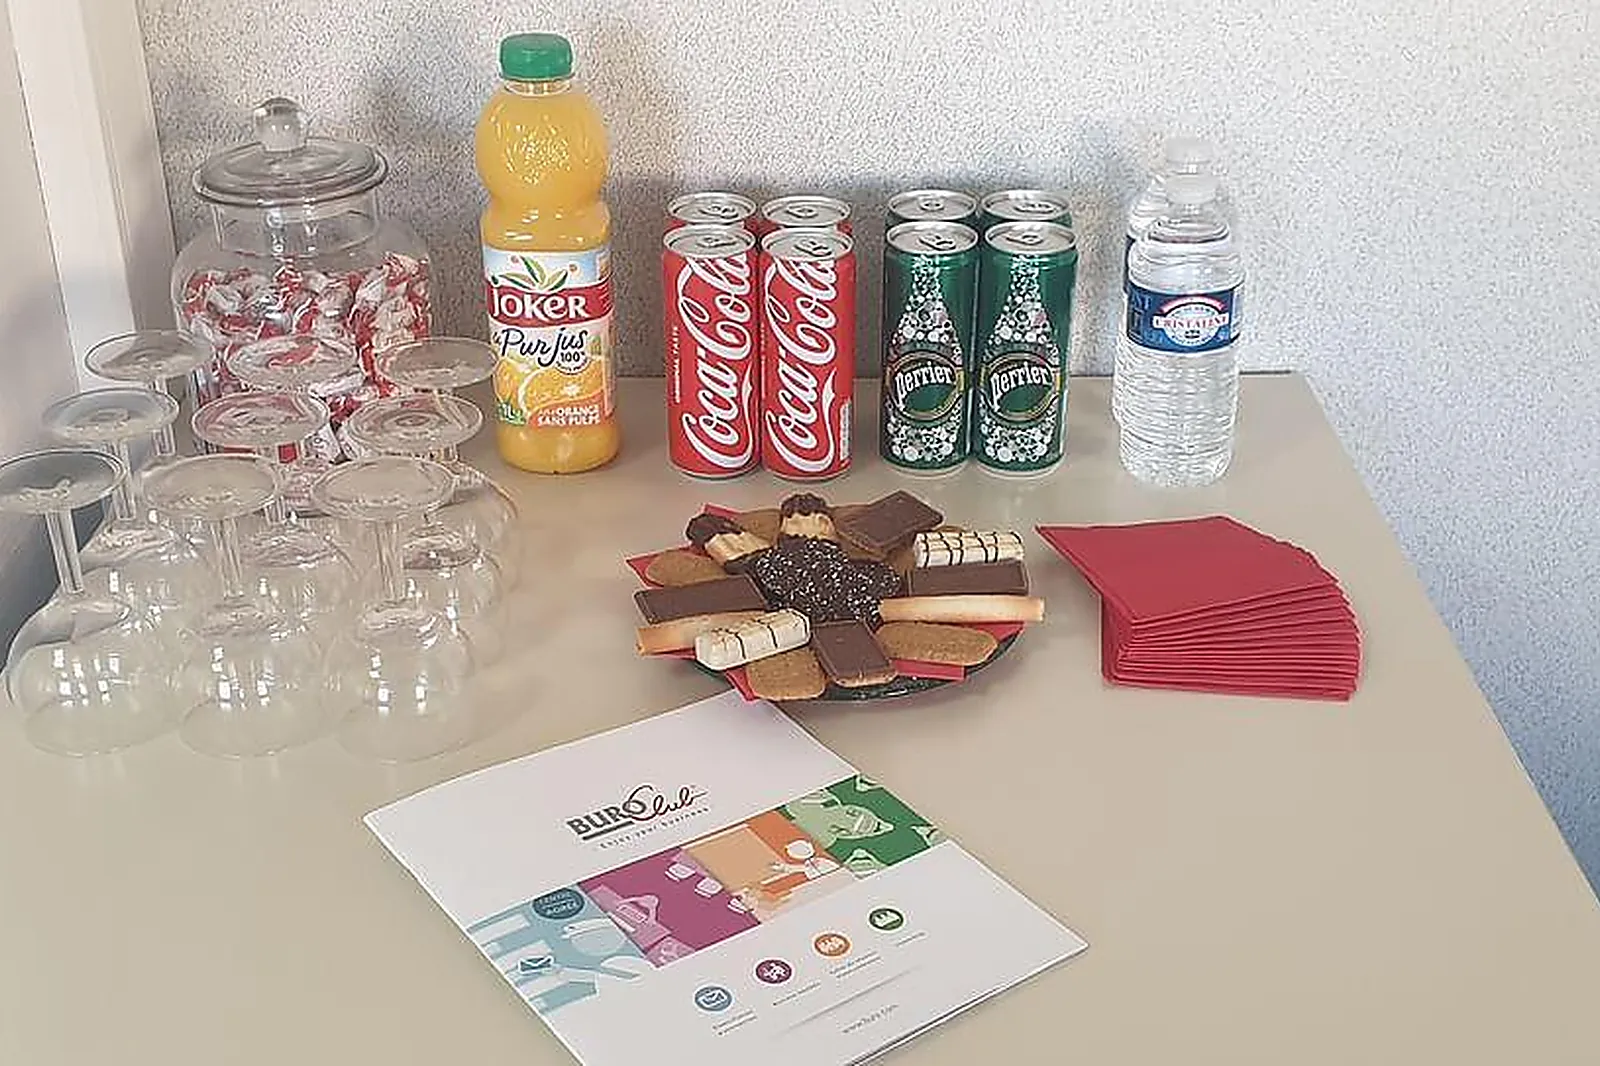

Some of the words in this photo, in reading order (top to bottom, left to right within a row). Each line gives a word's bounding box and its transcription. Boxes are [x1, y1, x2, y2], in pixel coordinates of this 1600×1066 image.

[502, 328, 554, 356] Pur
[538, 327, 588, 367] jus
[894, 361, 954, 413] Perrier
[990, 361, 1049, 413] Perrier
